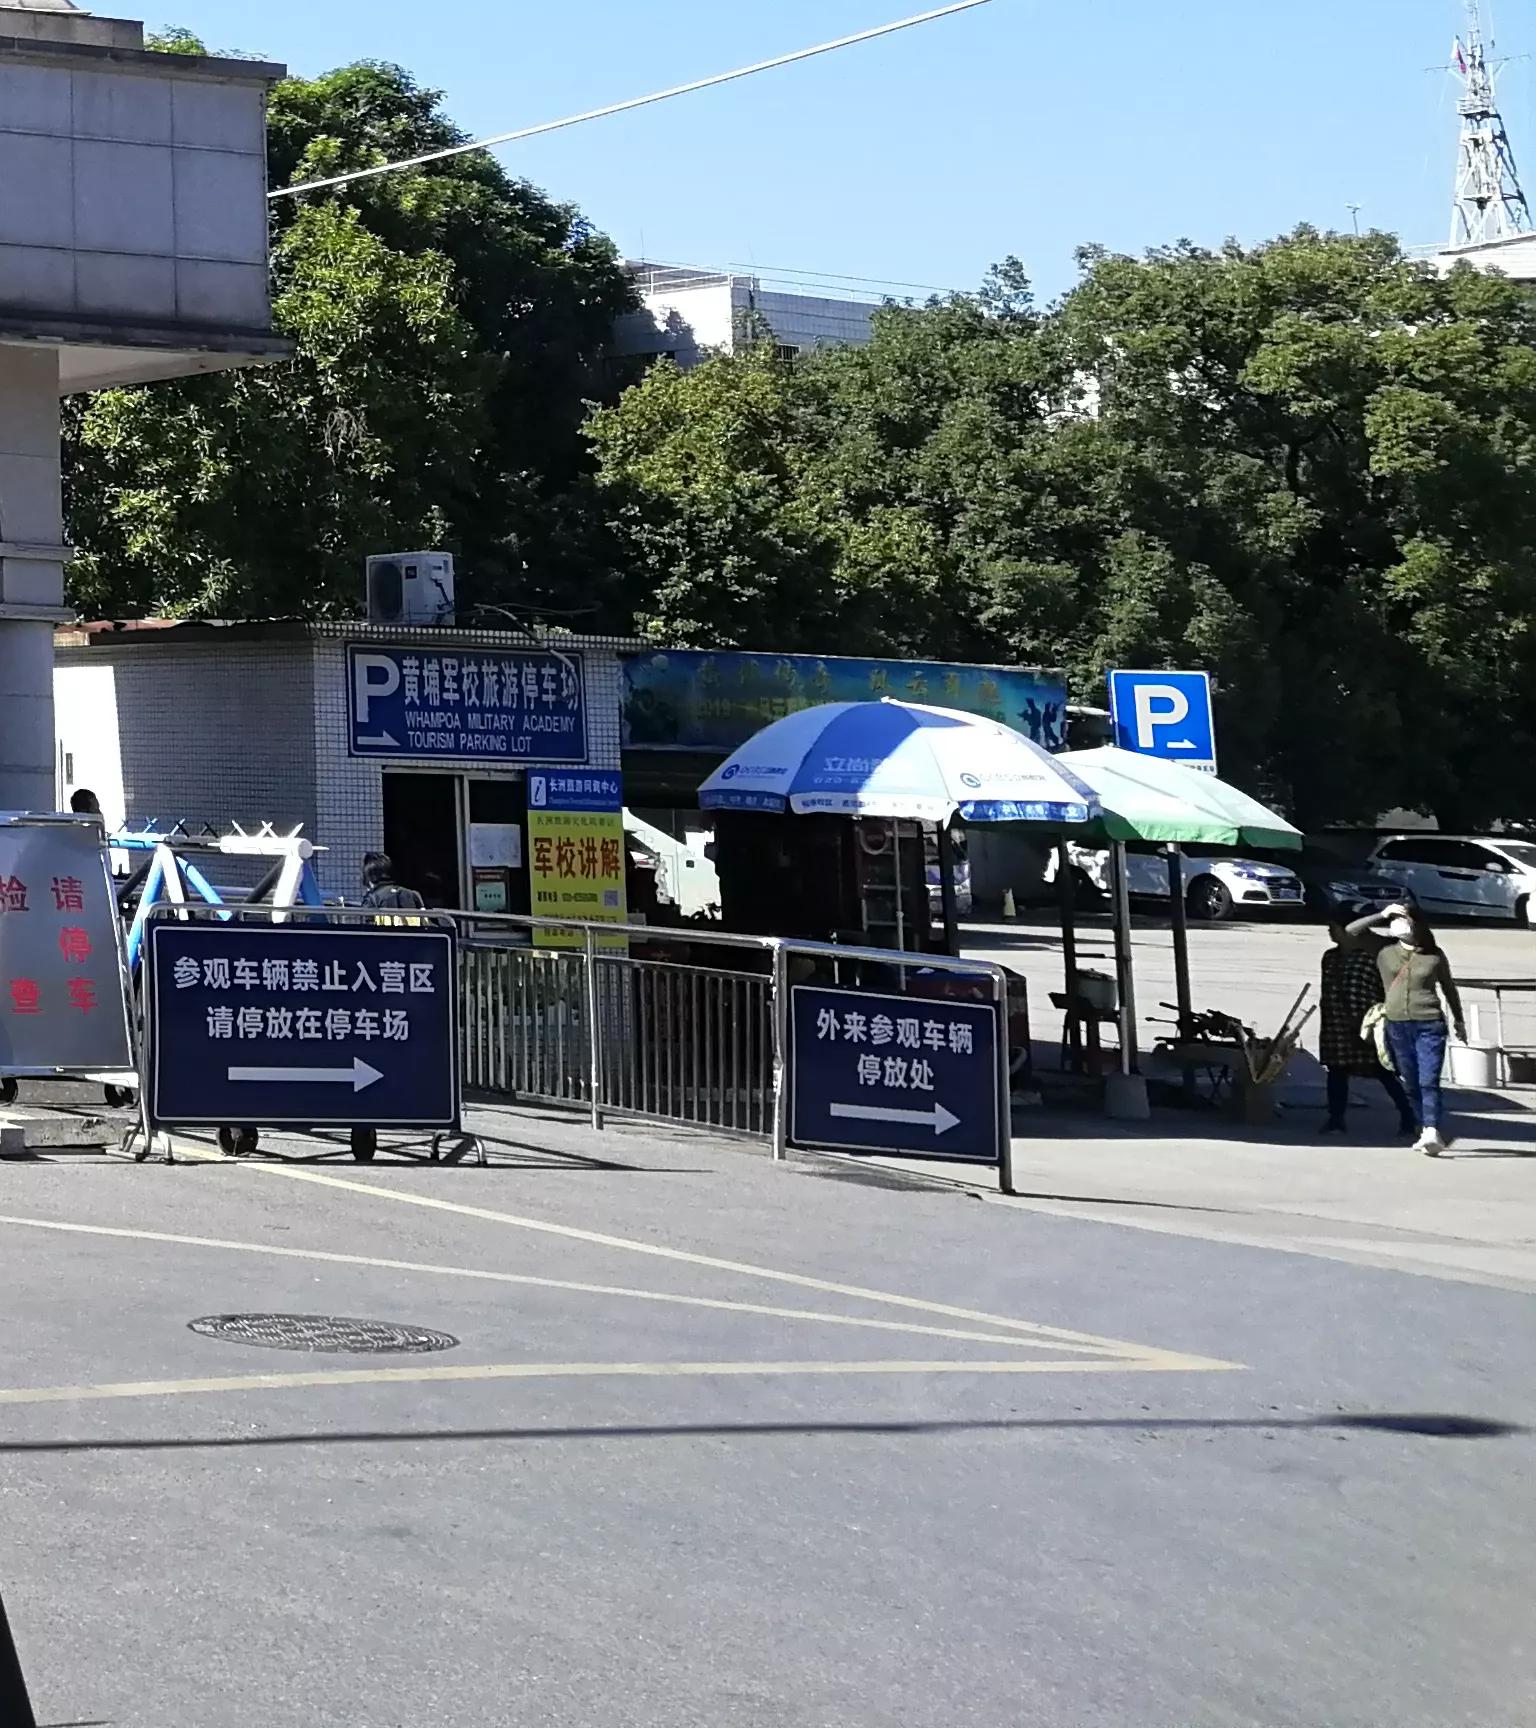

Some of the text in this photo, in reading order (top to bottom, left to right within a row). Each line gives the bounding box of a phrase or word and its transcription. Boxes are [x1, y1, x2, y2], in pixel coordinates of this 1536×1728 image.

[354, 653, 400, 723] P
[402, 655, 579, 711] 黄埔军校旅游停车场
[404, 710, 576, 733] WHAMPOA MILITARY ACADEMY
[1133, 684, 1189, 748] P
[407, 729, 533, 753] TOURISM PARKING LOT
[533, 835, 621, 880] 军校讲解
[173, 955, 436, 994] 参观车辆禁止入营区
[206, 1005, 410, 1041] 请停放在停车场
[816, 1008, 974, 1055] 外来参观车辆
[857, 1053, 935, 1091] 停放处
